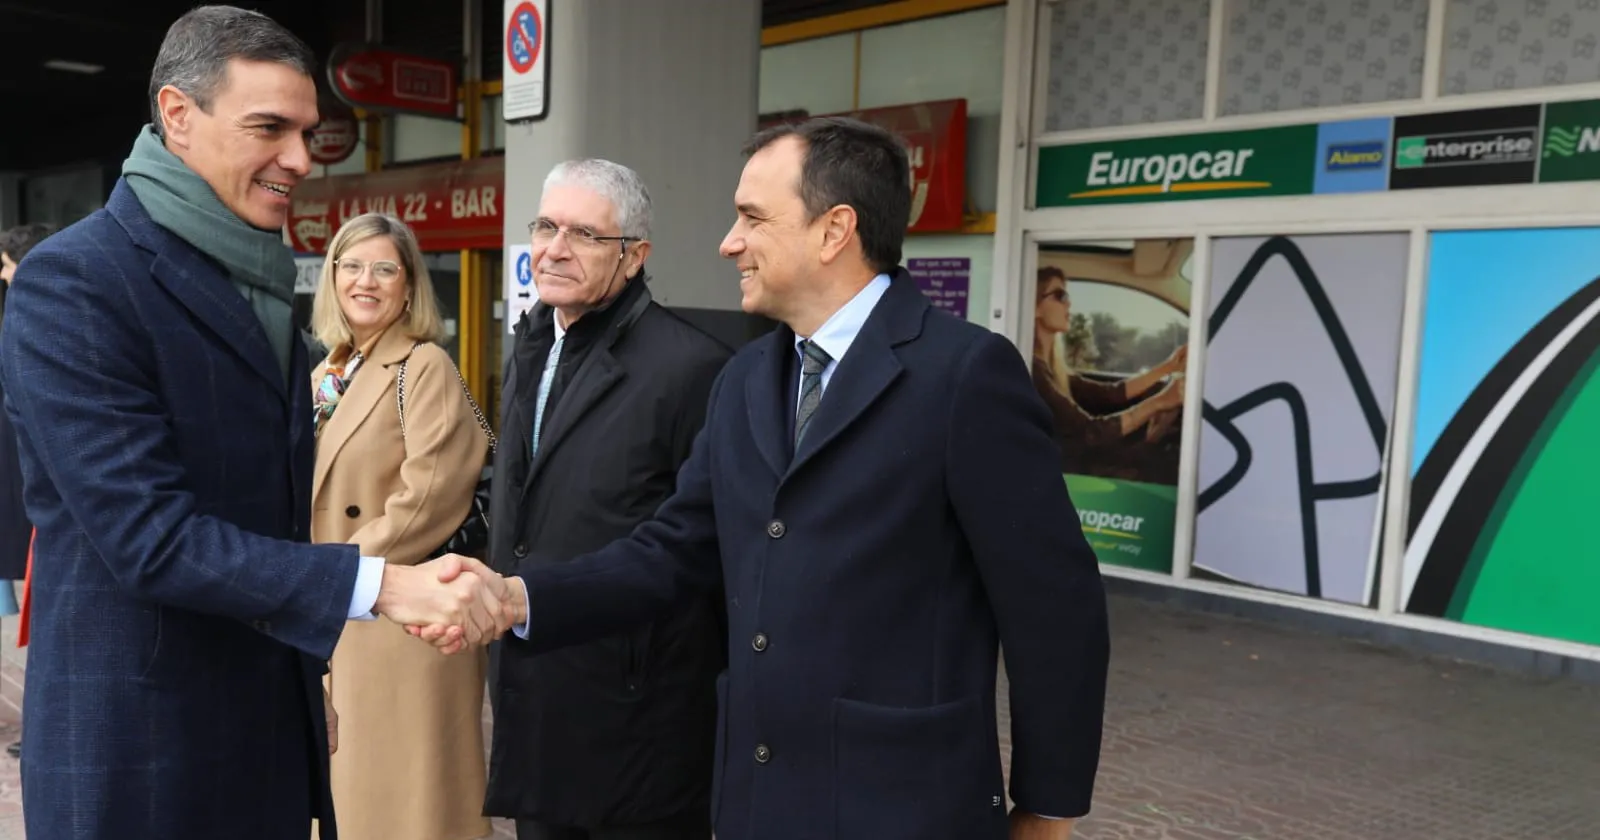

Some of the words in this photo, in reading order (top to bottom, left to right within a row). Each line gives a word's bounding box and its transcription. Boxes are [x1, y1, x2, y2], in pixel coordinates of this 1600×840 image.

[1328, 151, 1382, 165] Alamo
[1398, 135, 1532, 160] enterprise
[1086, 148, 1254, 193] Europcar
[339, 198, 360, 226] LA
[366, 195, 398, 220] VIA
[404, 192, 428, 221] 22
[451, 186, 497, 219] BAR
[1076, 508, 1145, 533] ropcar
